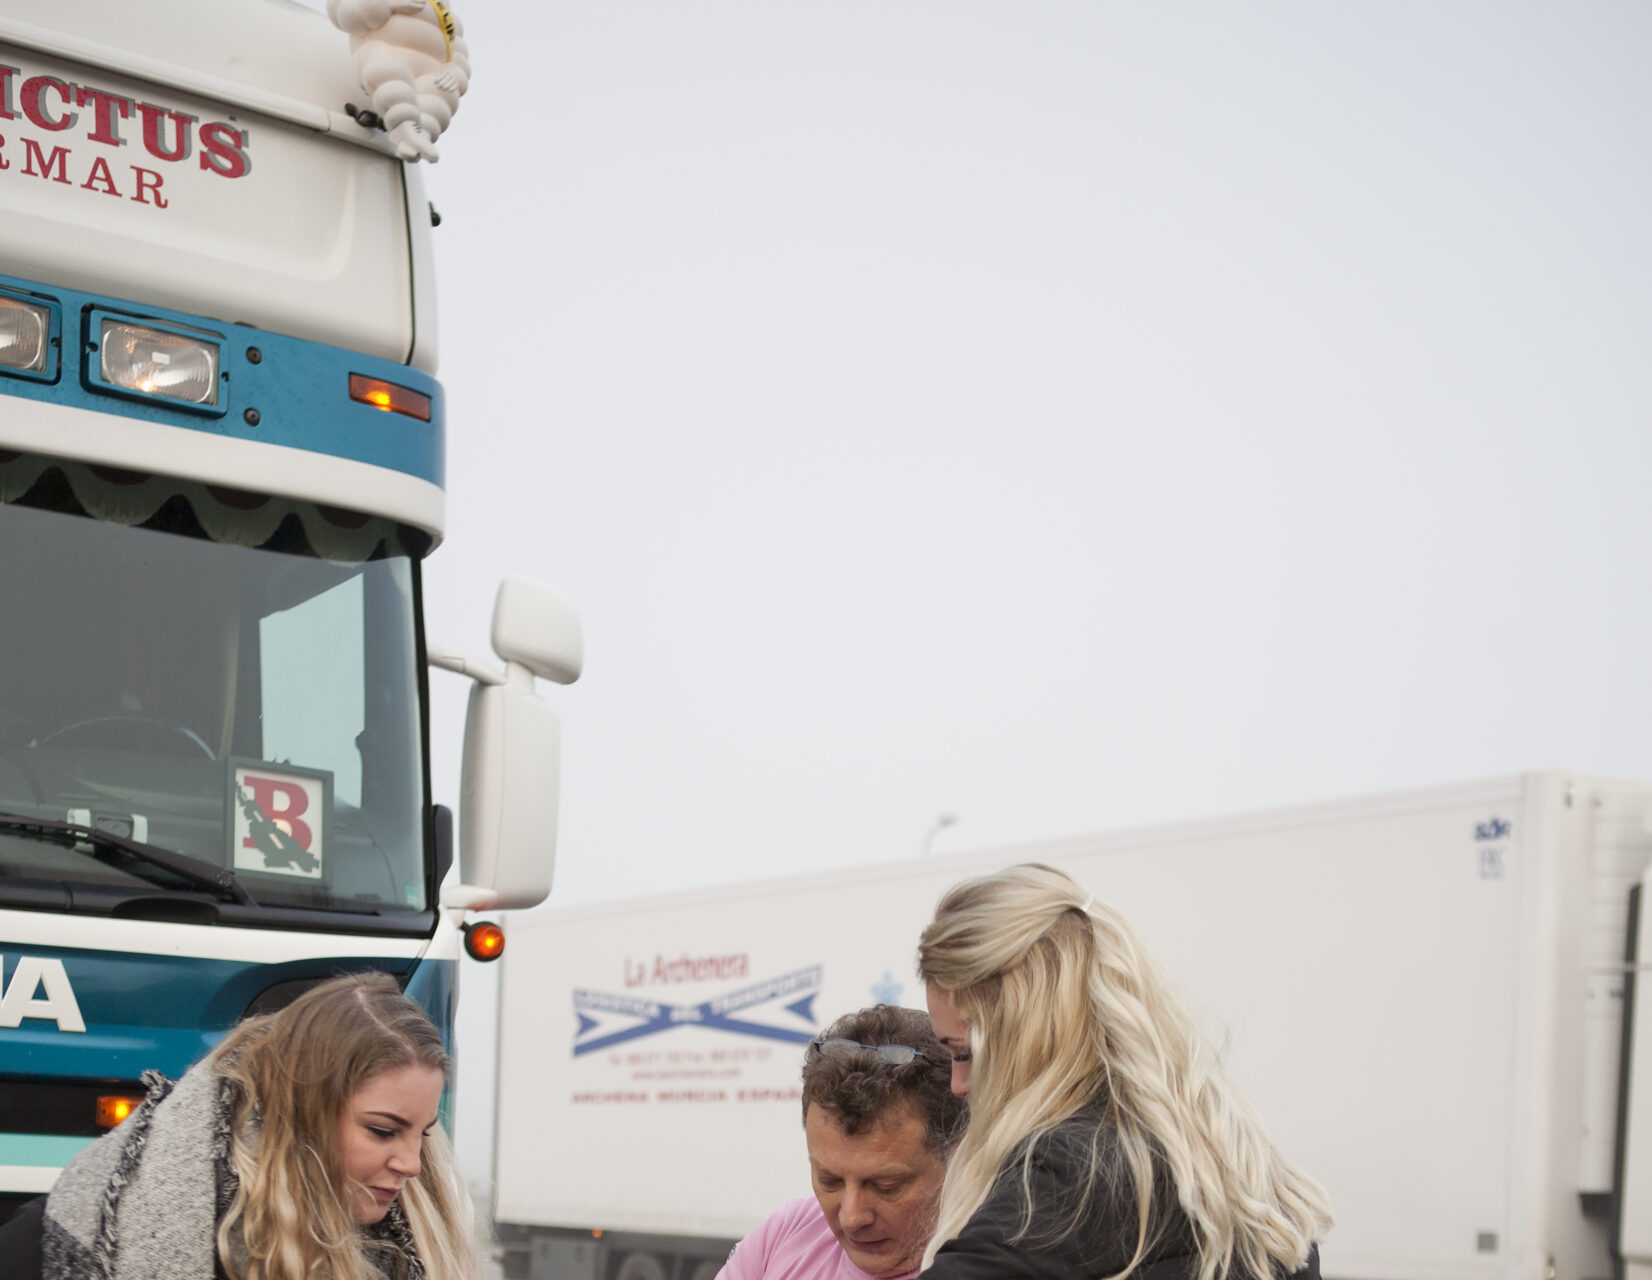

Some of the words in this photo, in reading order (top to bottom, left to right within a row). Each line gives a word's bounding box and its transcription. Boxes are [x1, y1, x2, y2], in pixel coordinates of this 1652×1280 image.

[0, 133, 168, 209] MAR
[0, 954, 86, 1033] A
[623, 957, 646, 988] La
[650, 952, 749, 986] Archenera
[572, 1089, 649, 1104] ARCHENA
[658, 1088, 728, 1103] MURCIA
[736, 1086, 803, 1103] ESPAÑ
